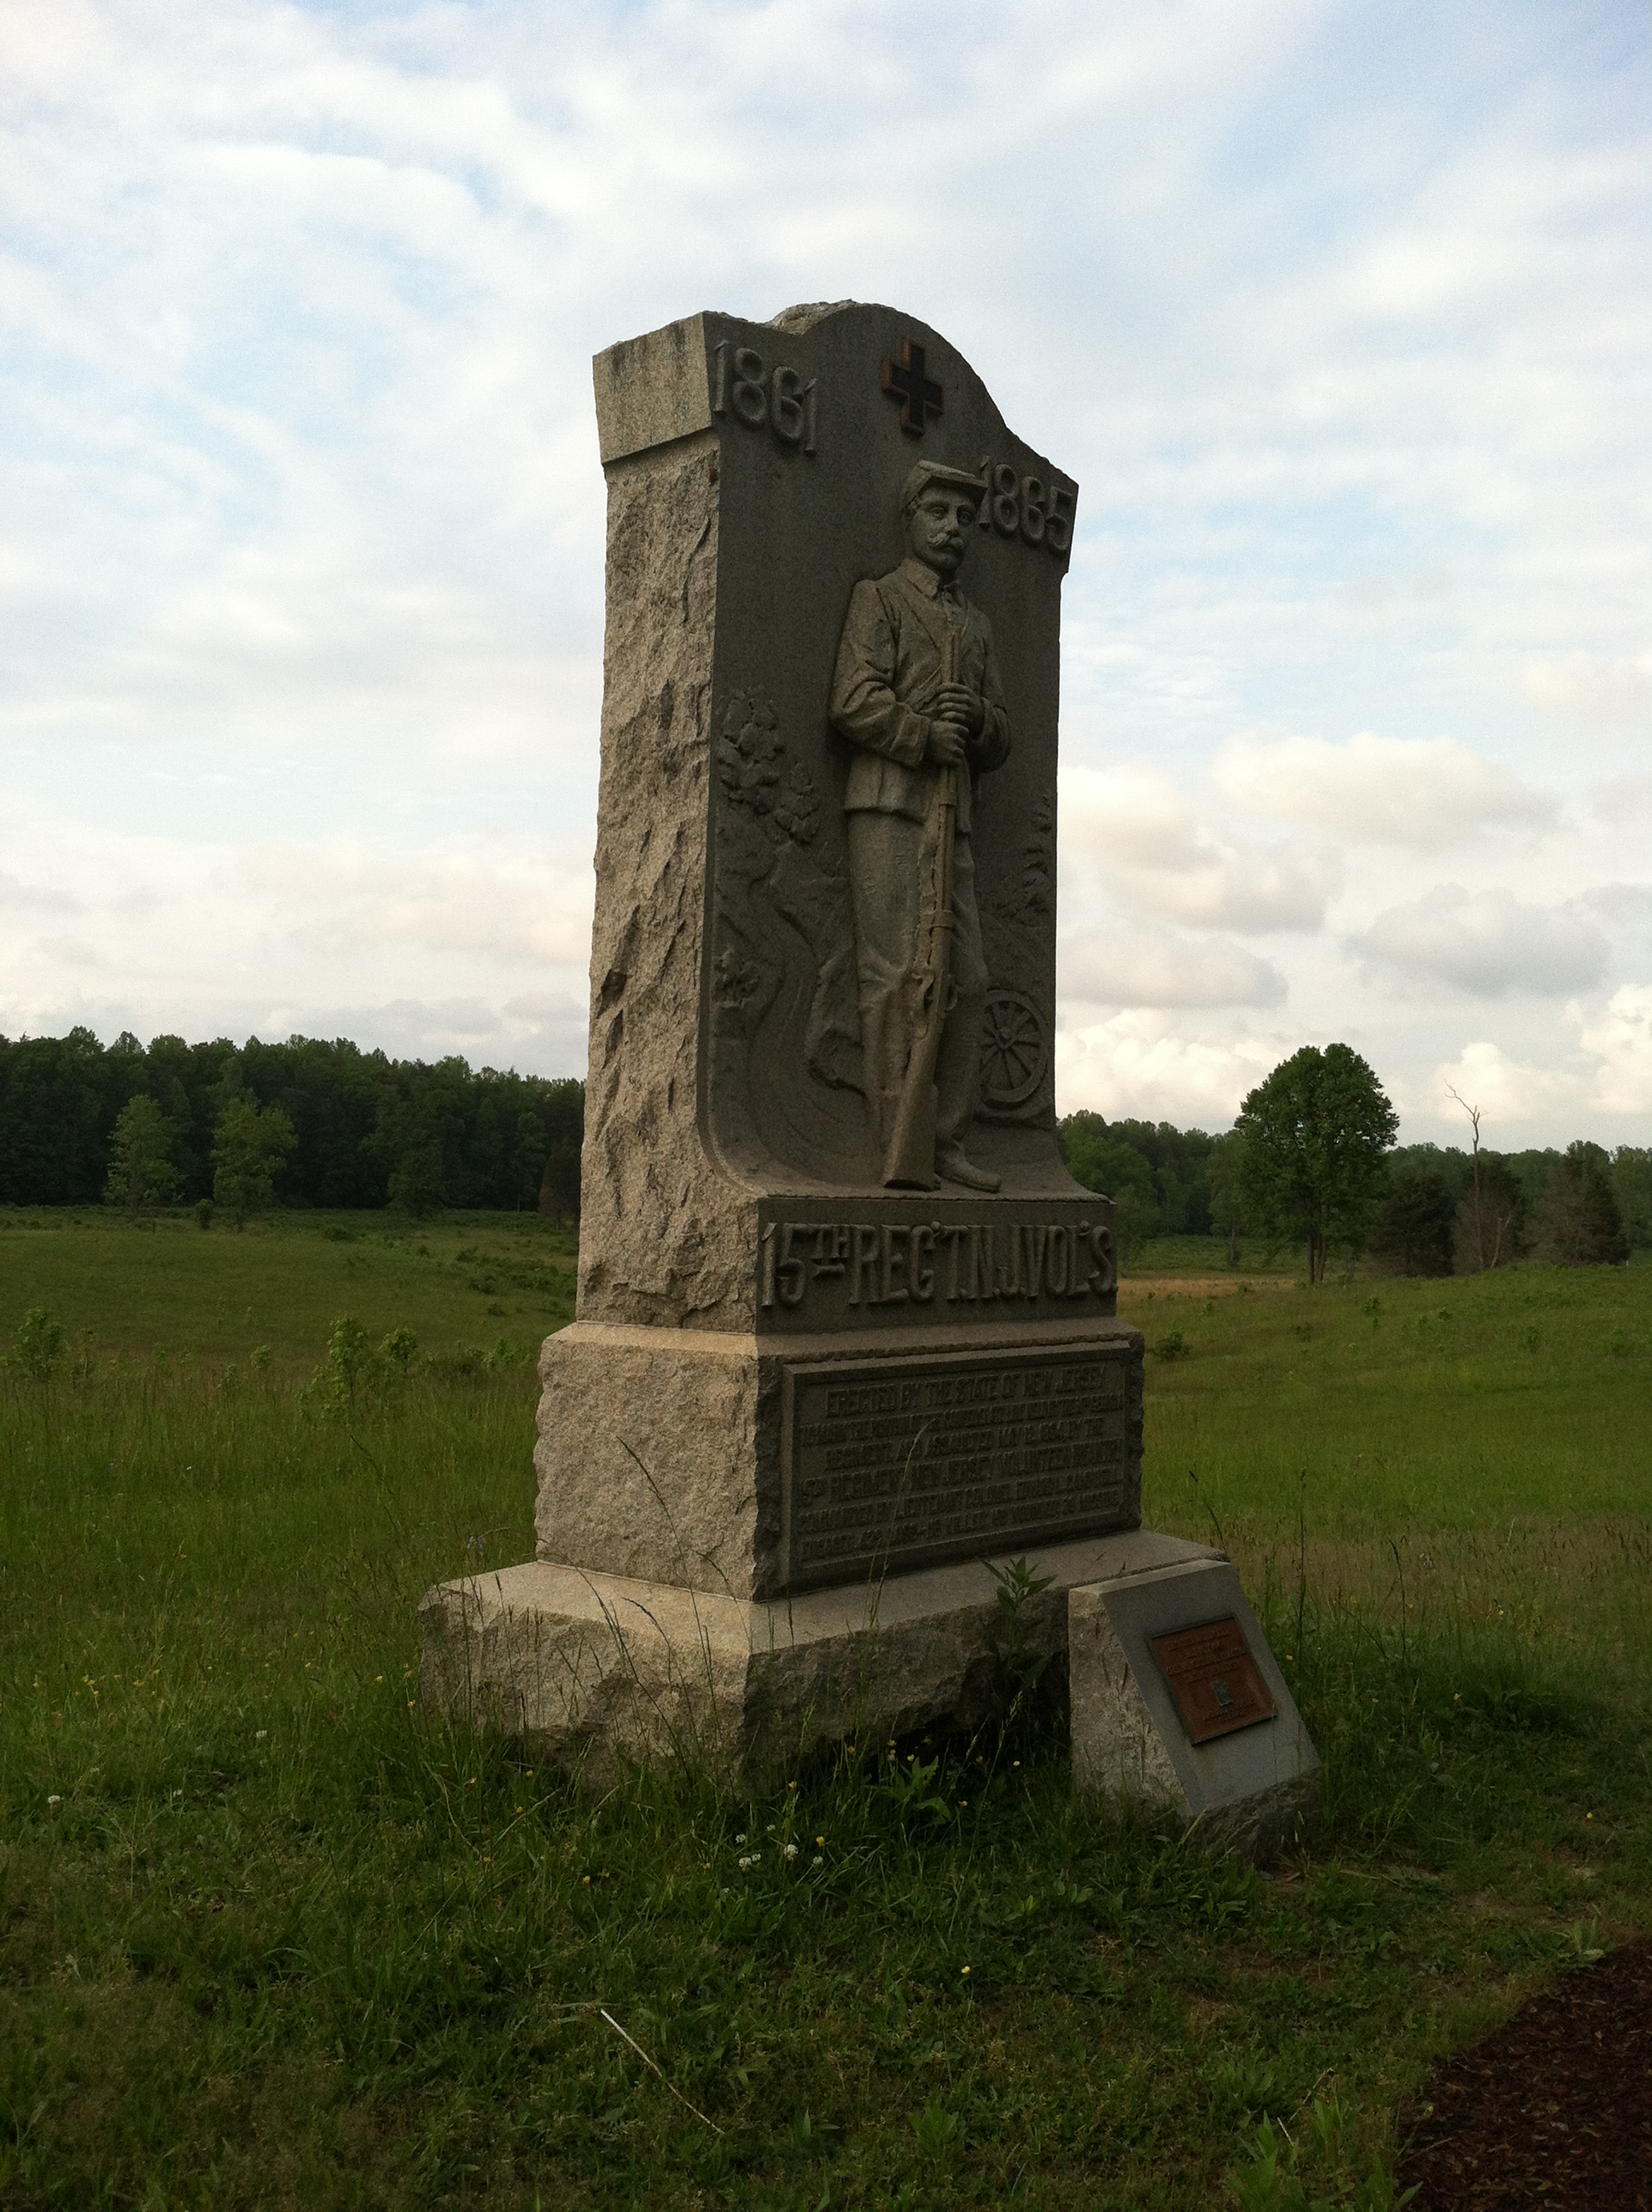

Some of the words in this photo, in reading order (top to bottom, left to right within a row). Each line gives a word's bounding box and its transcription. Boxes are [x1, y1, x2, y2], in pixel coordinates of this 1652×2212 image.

[713, 339, 818, 457] 1861
[976, 454, 1077, 554] 1865
[825, 1383, 896, 1416] ERECTED
[899, 1381, 921, 1409] BY
[924, 1378, 953, 1407] THE
[956, 1374, 998, 1404] STATE
[1001, 1371, 1021, 1400] OF
[1023, 1369, 1053, 1397] NEW
[1054, 1364, 1105, 1394] JERSEY
